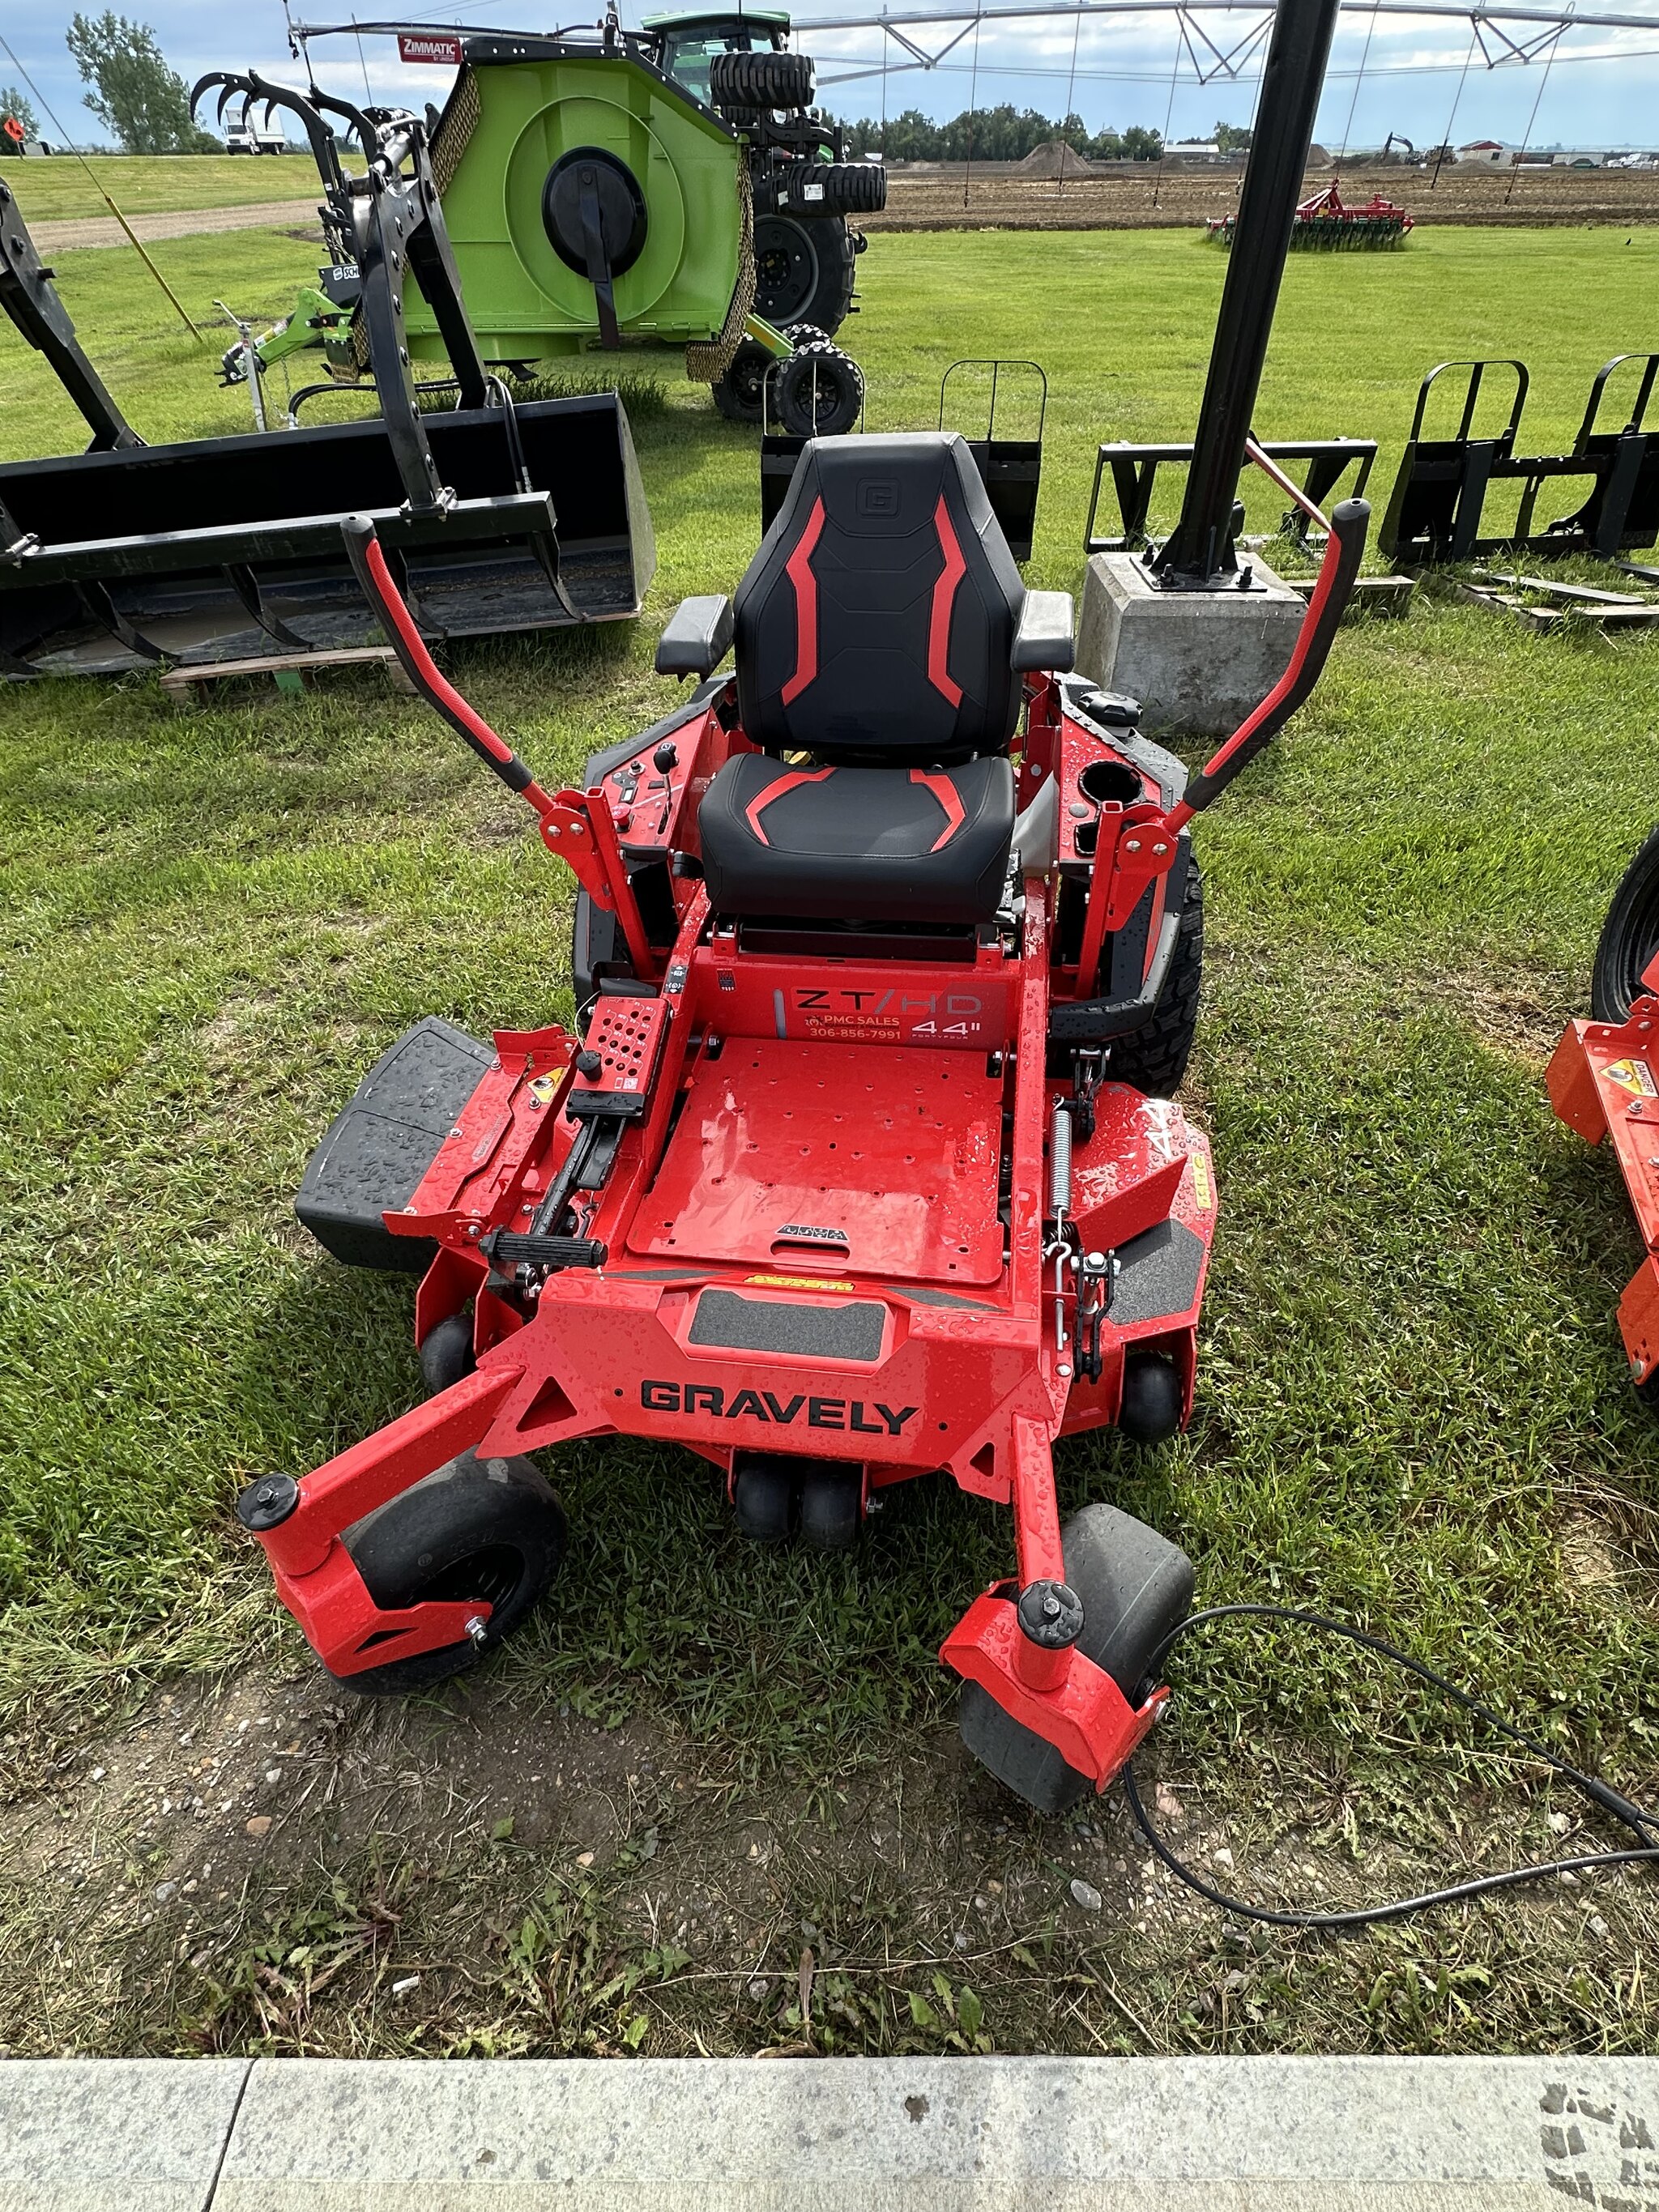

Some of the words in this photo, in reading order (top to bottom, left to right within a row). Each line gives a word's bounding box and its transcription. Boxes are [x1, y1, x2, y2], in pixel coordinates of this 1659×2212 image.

[403, 38, 455, 55] ZIMMATIC
[343, 266, 360, 279] SCH
[824, 1015, 854, 1024] PMC
[857, 1016, 900, 1026] SALES
[810, 1028, 901, 1039] 306-856-7991
[1636, 1063, 1654, 1093] DANGER
[641, 1379, 920, 1435] GRAVELY
